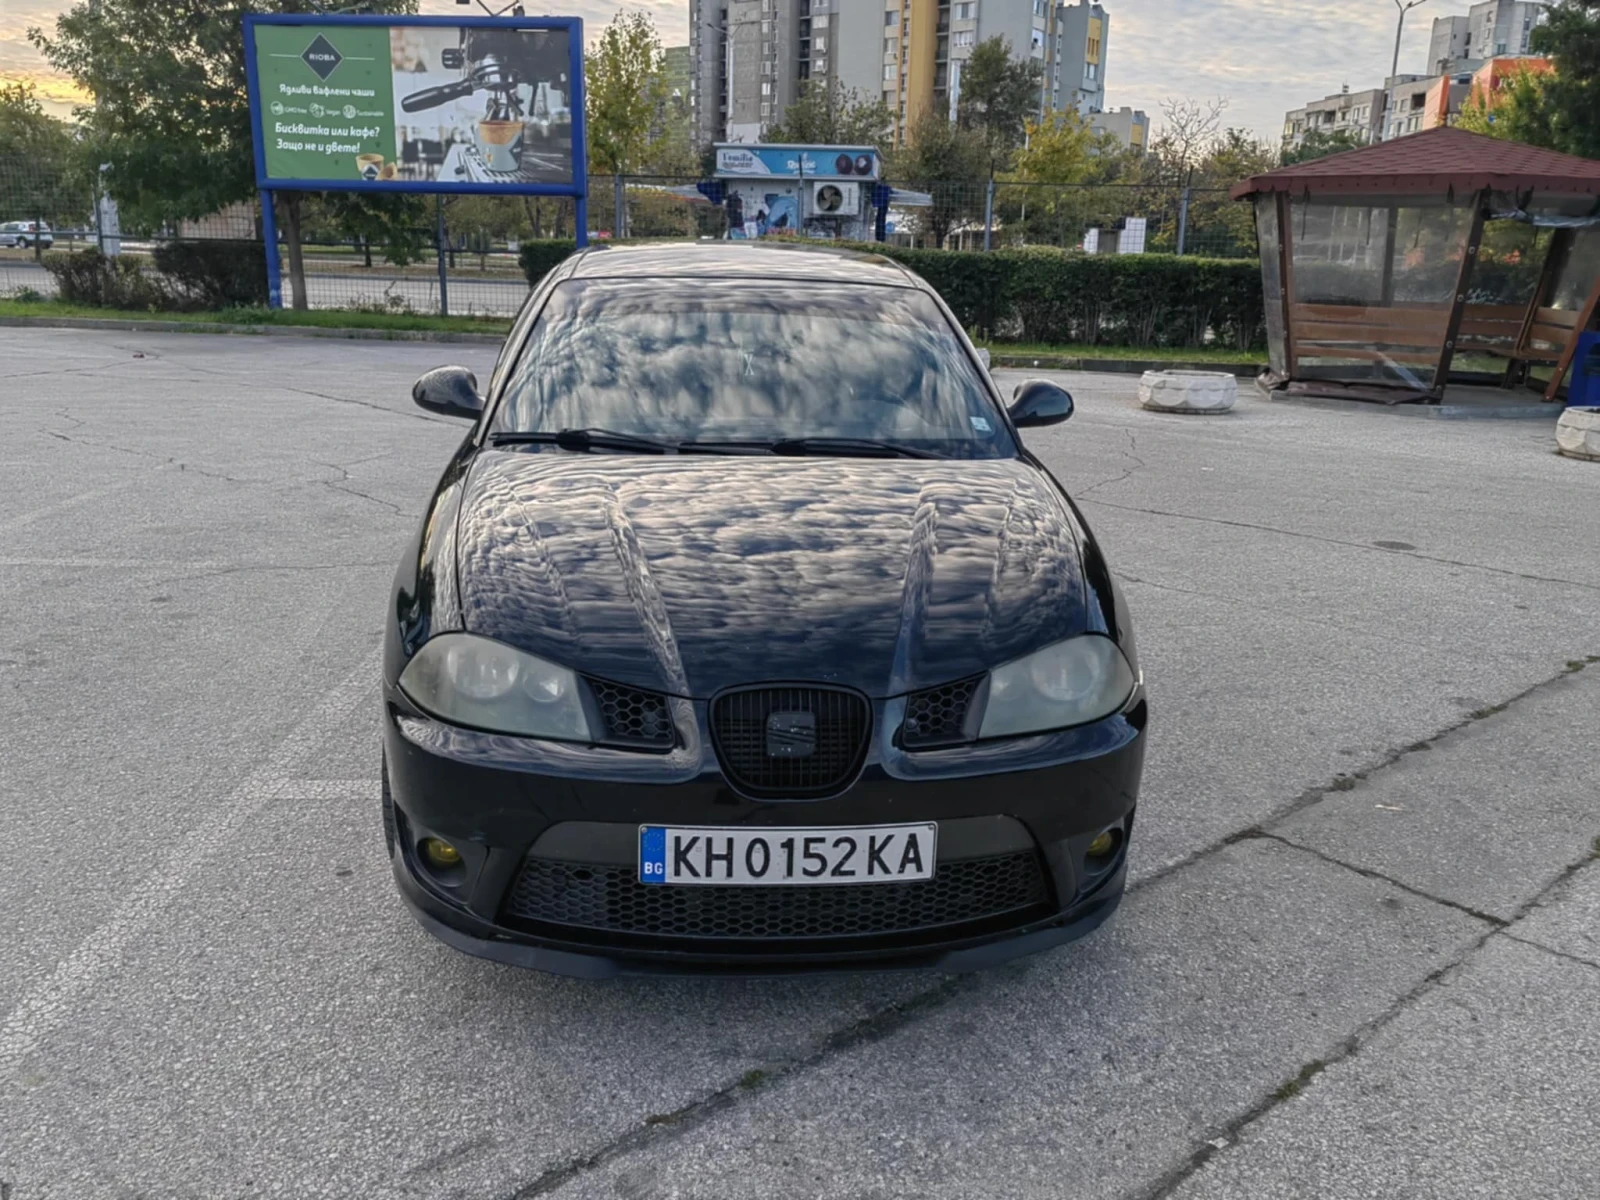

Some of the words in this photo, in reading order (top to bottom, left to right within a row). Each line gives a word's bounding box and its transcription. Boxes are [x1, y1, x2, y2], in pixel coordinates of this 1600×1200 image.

[309, 53, 335, 61] RIOBA
[279, 83, 311, 95] Ядливи
[312, 85, 350, 97] вафлени
[351, 89, 375, 97] чаши
[275, 122, 330, 136] Бисквитка
[331, 128, 349, 136] или
[350, 126, 380, 139] кафе?
[276, 138, 303, 151] Защо
[304, 143, 317, 151] не
[317, 143, 325, 151] и
[325, 141, 361, 154] двете!
[644, 861, 663, 874] BG
